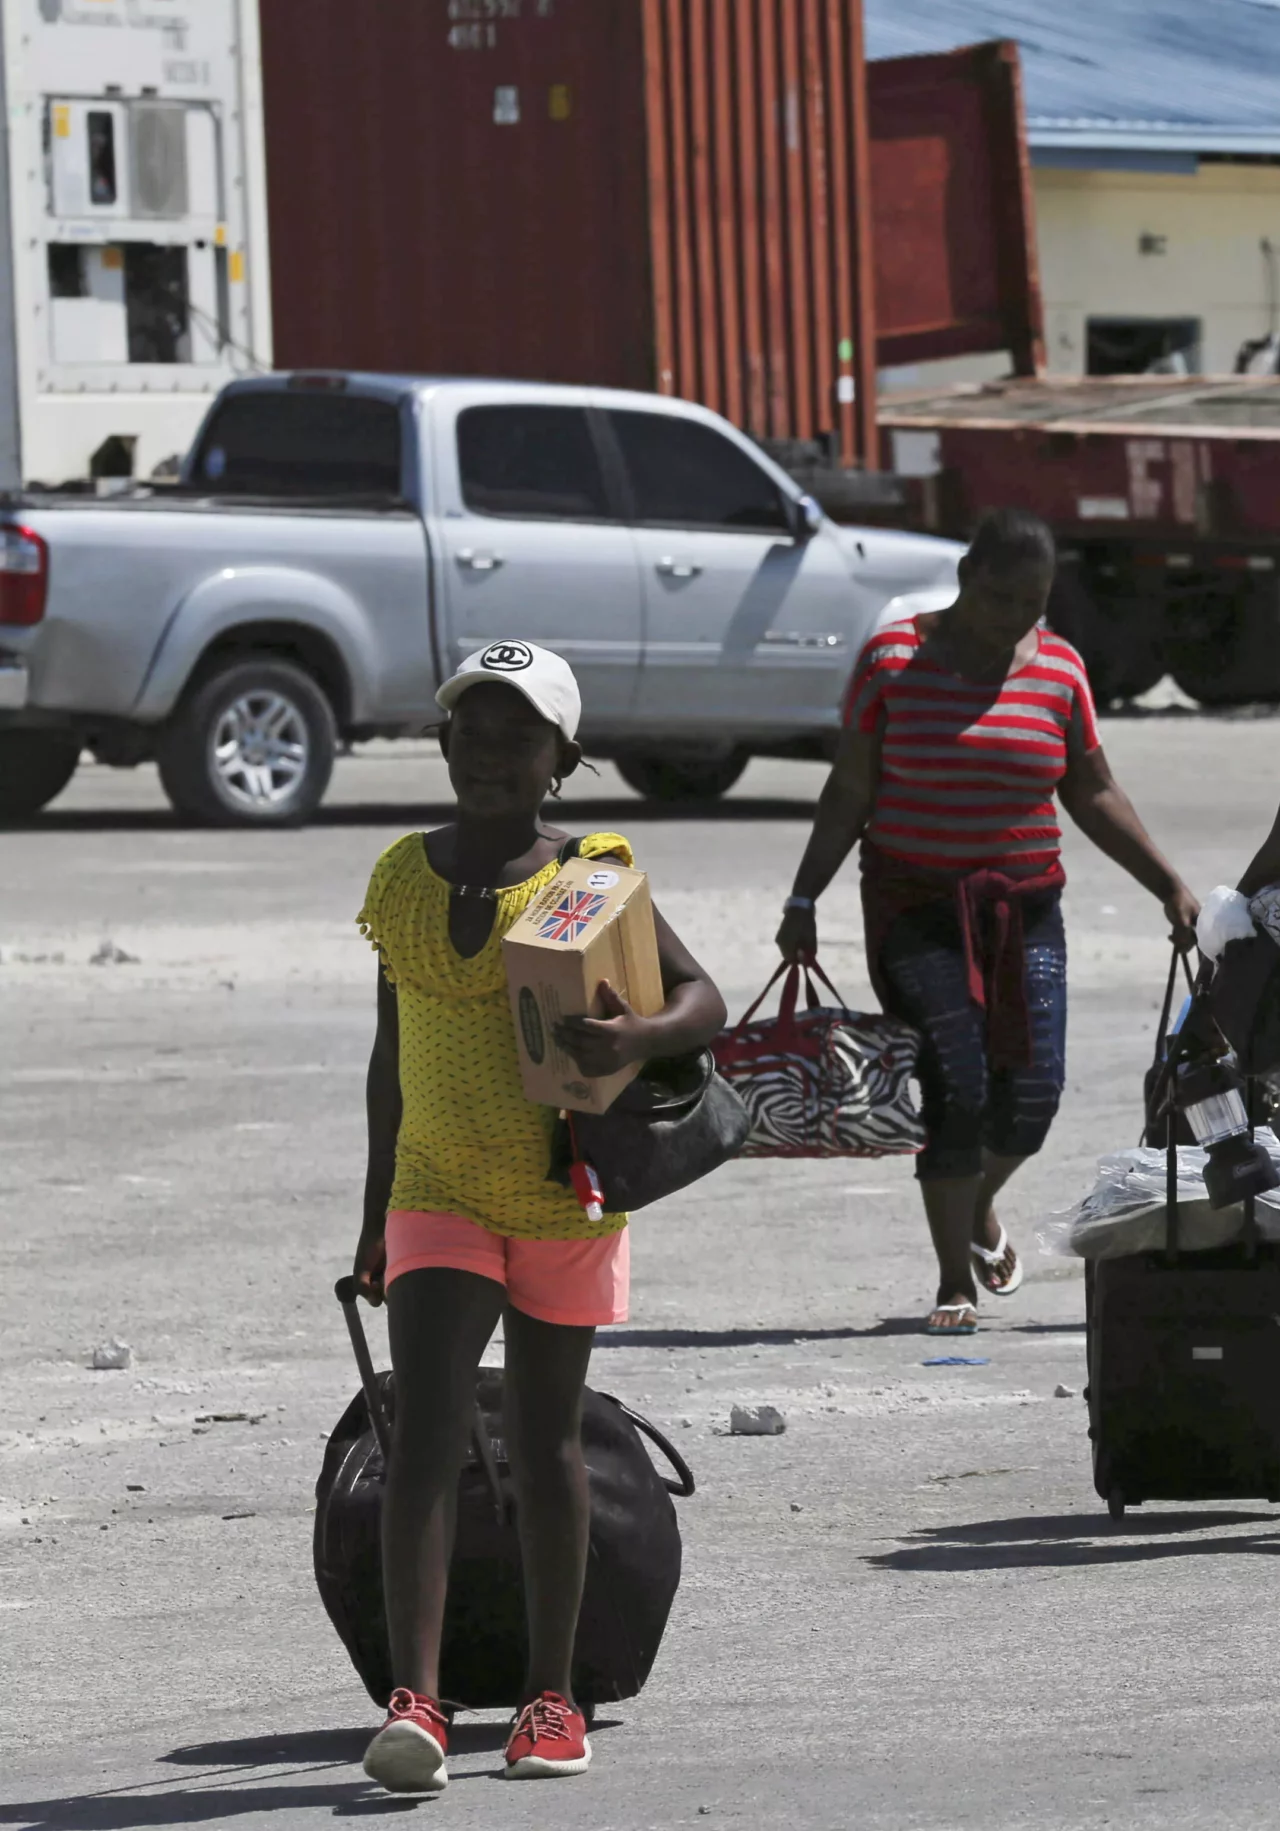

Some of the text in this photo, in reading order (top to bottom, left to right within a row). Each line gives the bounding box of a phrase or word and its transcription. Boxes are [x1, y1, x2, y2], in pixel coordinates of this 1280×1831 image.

[590, 874, 608, 886] 11
[539, 890, 556, 906] RATION
[550, 880, 564, 891] PACK
[532, 910, 549, 925] RATION
